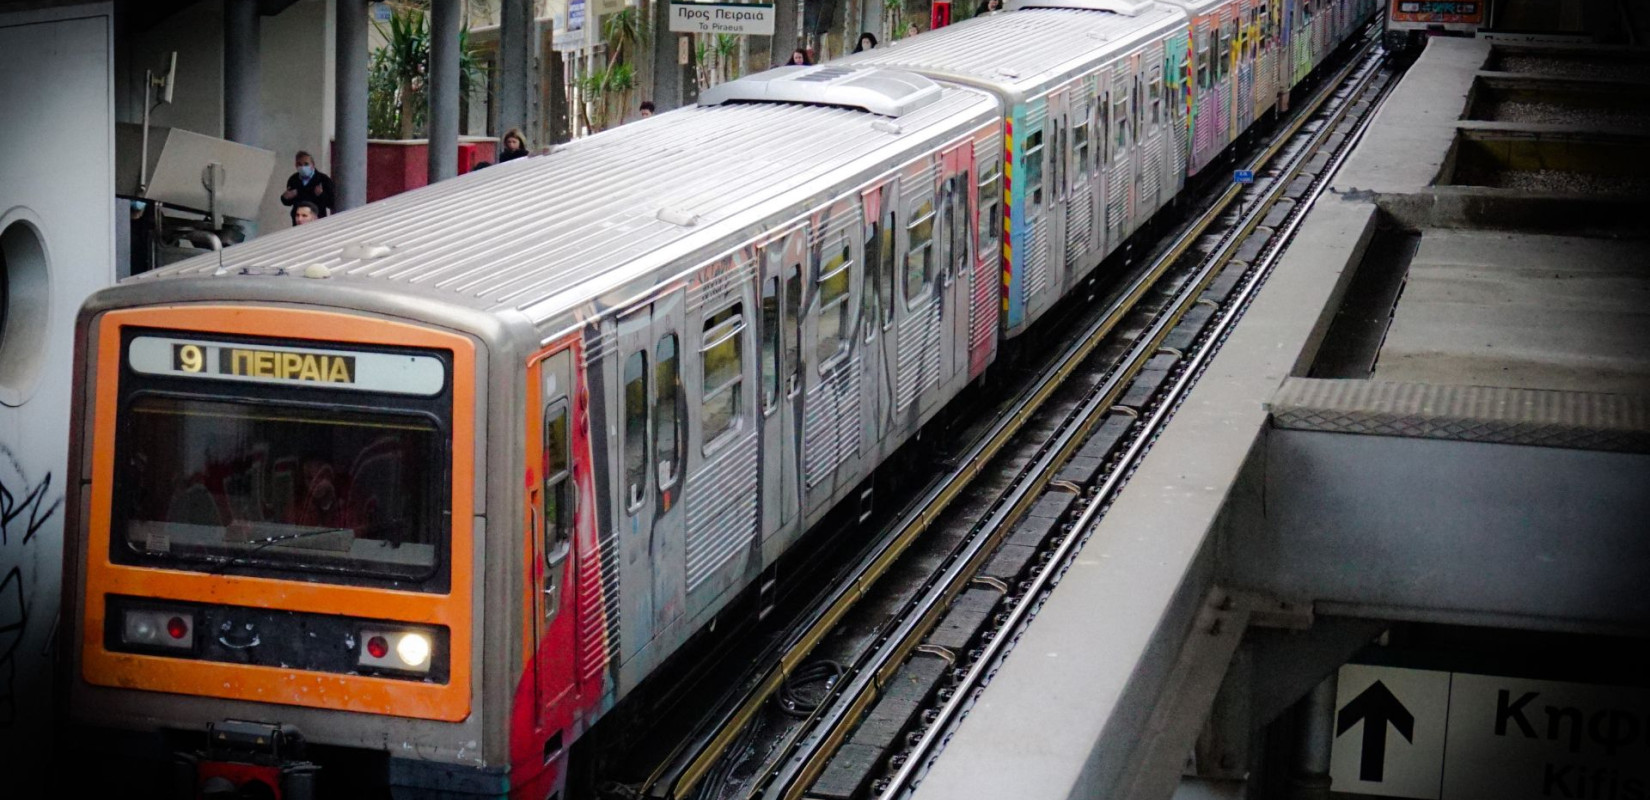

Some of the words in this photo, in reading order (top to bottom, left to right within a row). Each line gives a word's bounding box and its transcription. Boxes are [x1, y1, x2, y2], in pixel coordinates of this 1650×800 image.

[678, 7, 710, 21] Προς
[715, 8, 765, 22] Πειραιά
[698, 22, 709, 30] To
[712, 22, 744, 32] Piraeus
[180, 344, 203, 374] 9
[231, 349, 352, 383] ΠΕΙΡΑΙΑ
[1543, 762, 1649, 800] Kifis
